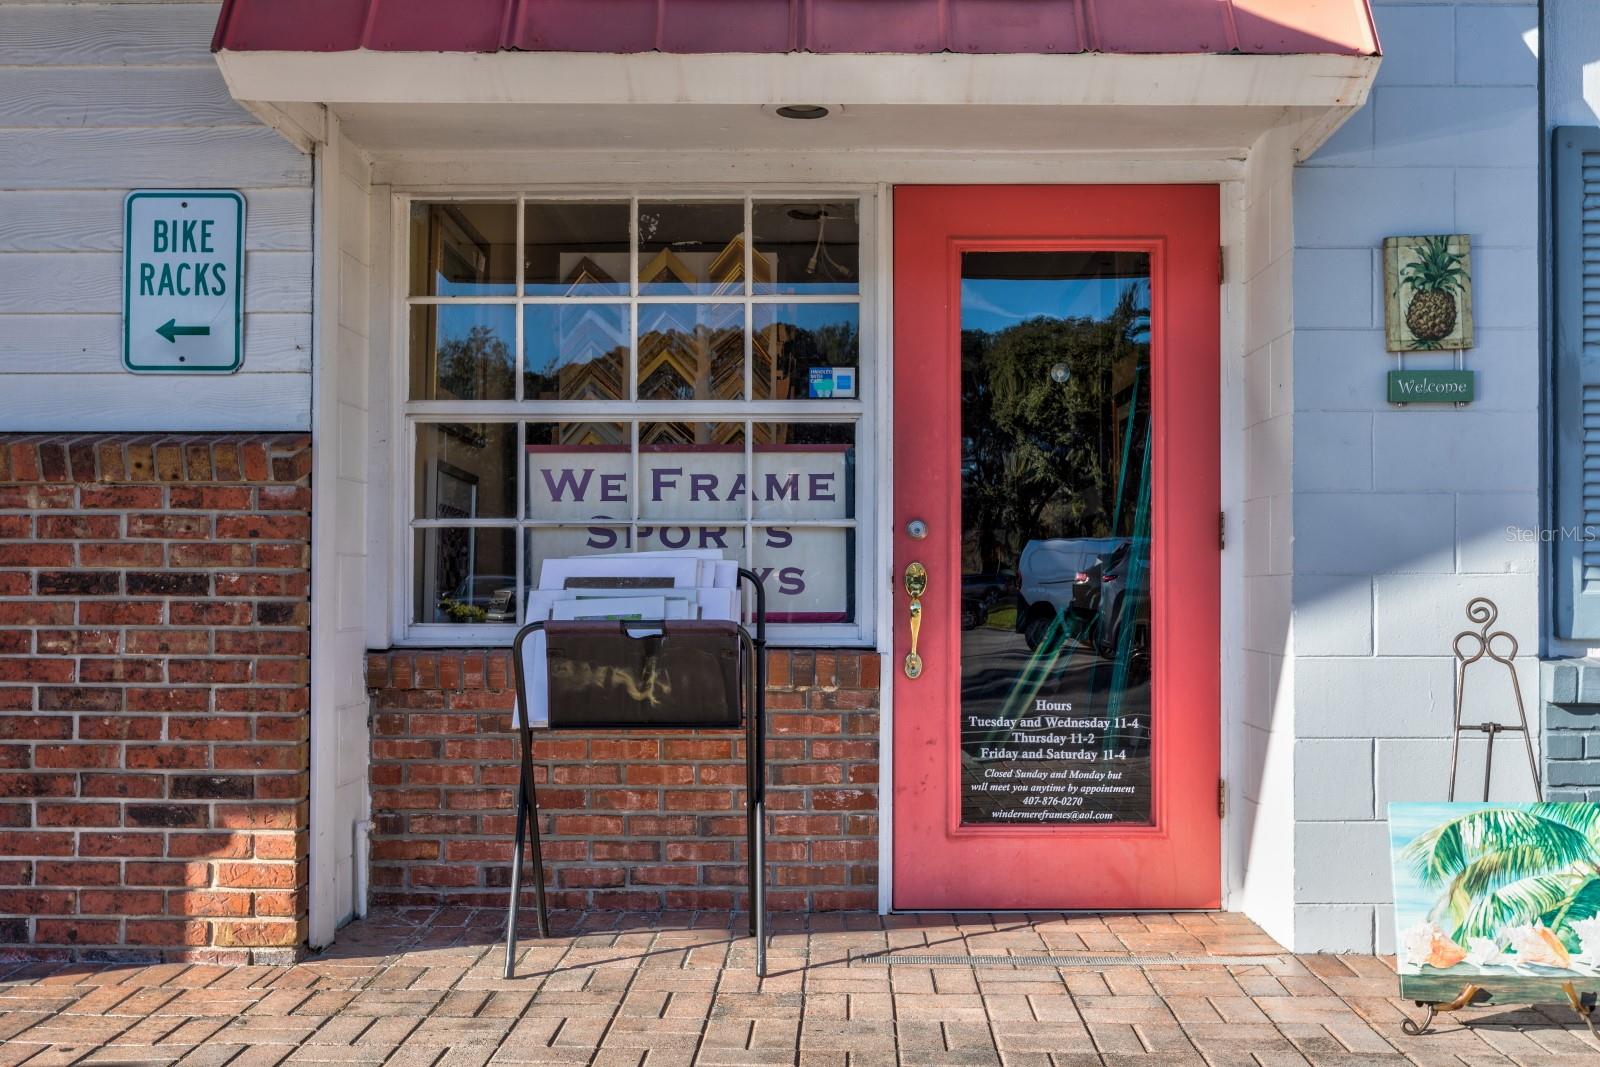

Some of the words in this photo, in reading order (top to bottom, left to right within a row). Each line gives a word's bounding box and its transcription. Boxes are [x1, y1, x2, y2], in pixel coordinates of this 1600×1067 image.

[153, 219, 215, 253] BIKE
[139, 262, 227, 297] RACKS
[1397, 377, 1468, 395] Welcome
[585, 515, 794, 549] SPORS
[1035, 699, 1073, 712] Hours
[968, 715, 1018, 730] Tuesday
[1019, 715, 1042, 728] and
[1044, 716, 1111, 731] Wednesday
[1114, 717, 1140, 729] 11-4
[1011, 732, 1067, 746] Thursday
[1070, 733, 1095, 744] 11-2
[980, 747, 1018, 761] Friday
[1021, 748, 1043, 760] and
[1046, 748, 1098, 762] Saturday
[1102, 749, 1127, 761] 11-4
[984, 768, 1013, 778] Closed
[1014, 769, 1048, 780] Sunday
[1049, 770, 1068, 779] and
[1068, 770, 1106, 781] Monday
[1107, 770, 1122, 780] but
[970, 782, 989, 791] will
[989, 784, 1011, 792] meet
[1012, 785, 1029, 793] you
[1030, 783, 1066, 793] anytime
[1067, 783, 1079, 793] by
[1080, 784, 1136, 795] appointment
[1022, 796, 1083, 806] 407-876-0270
[991, 808, 1113, 821] windermereframes@aol.com
